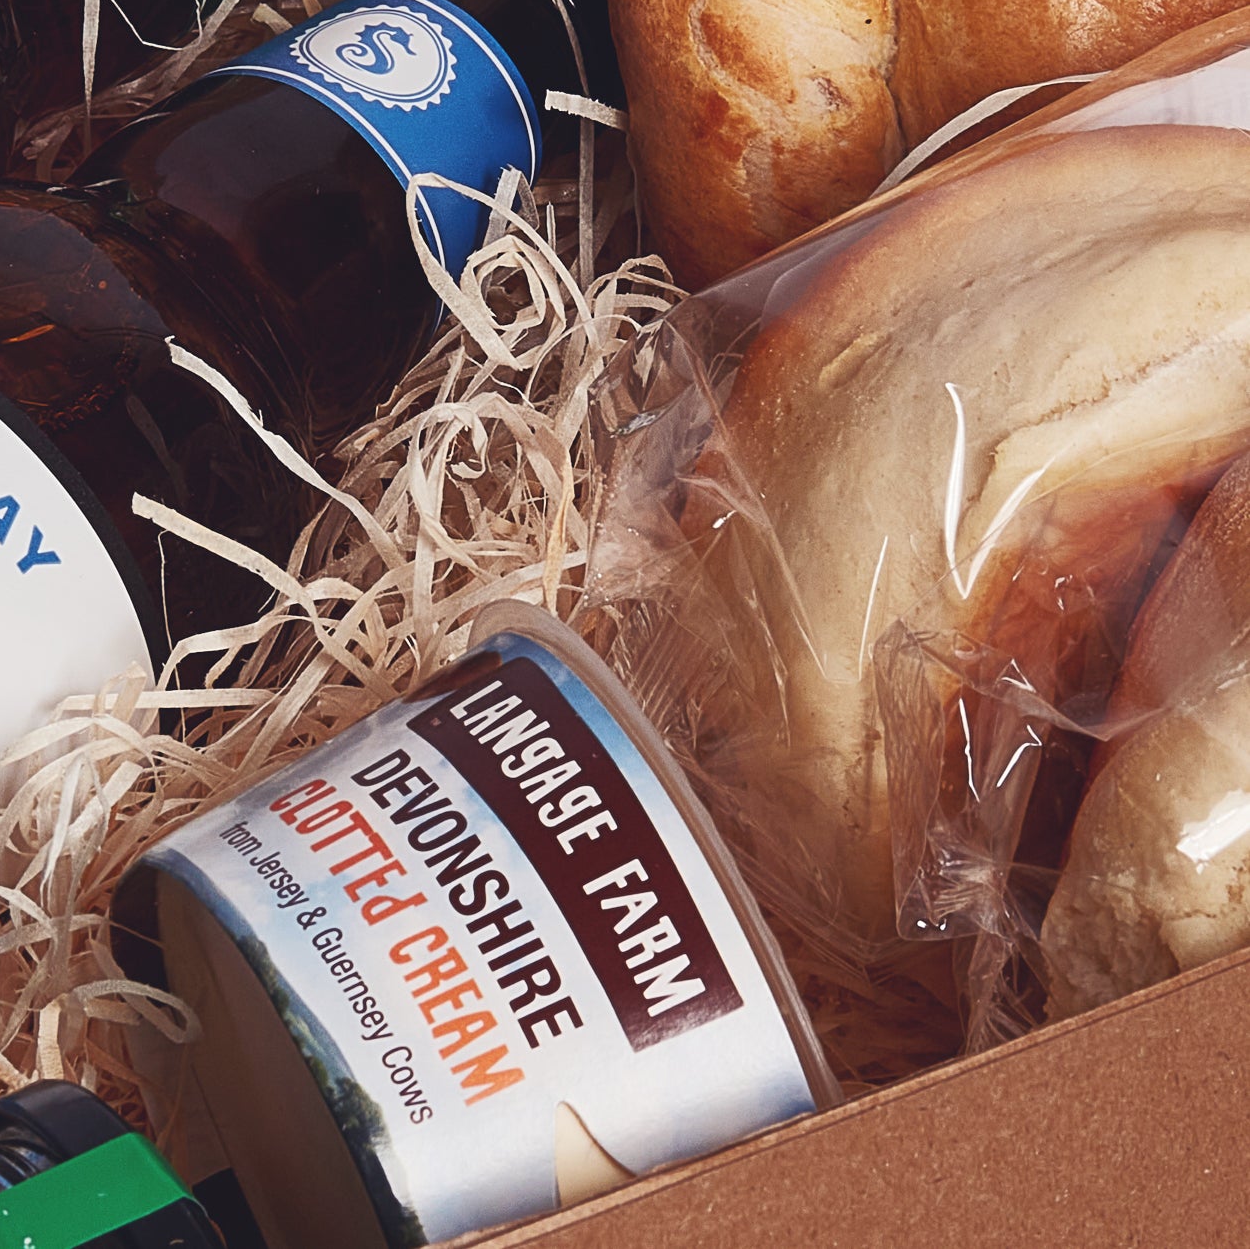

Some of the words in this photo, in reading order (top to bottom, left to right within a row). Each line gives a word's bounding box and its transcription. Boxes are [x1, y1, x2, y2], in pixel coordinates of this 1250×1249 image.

[219, 822, 262, 856] from
[250, 851, 309, 909] Jersey
[296, 907, 327, 930] &
[312, 927, 393, 1041] Guernsey
[381, 1046, 433, 1124] Cows
[351, 747, 584, 1050] DEVONSHIRE
[389, 925, 526, 1108] CREAM
[583, 858, 706, 1018] FARM
